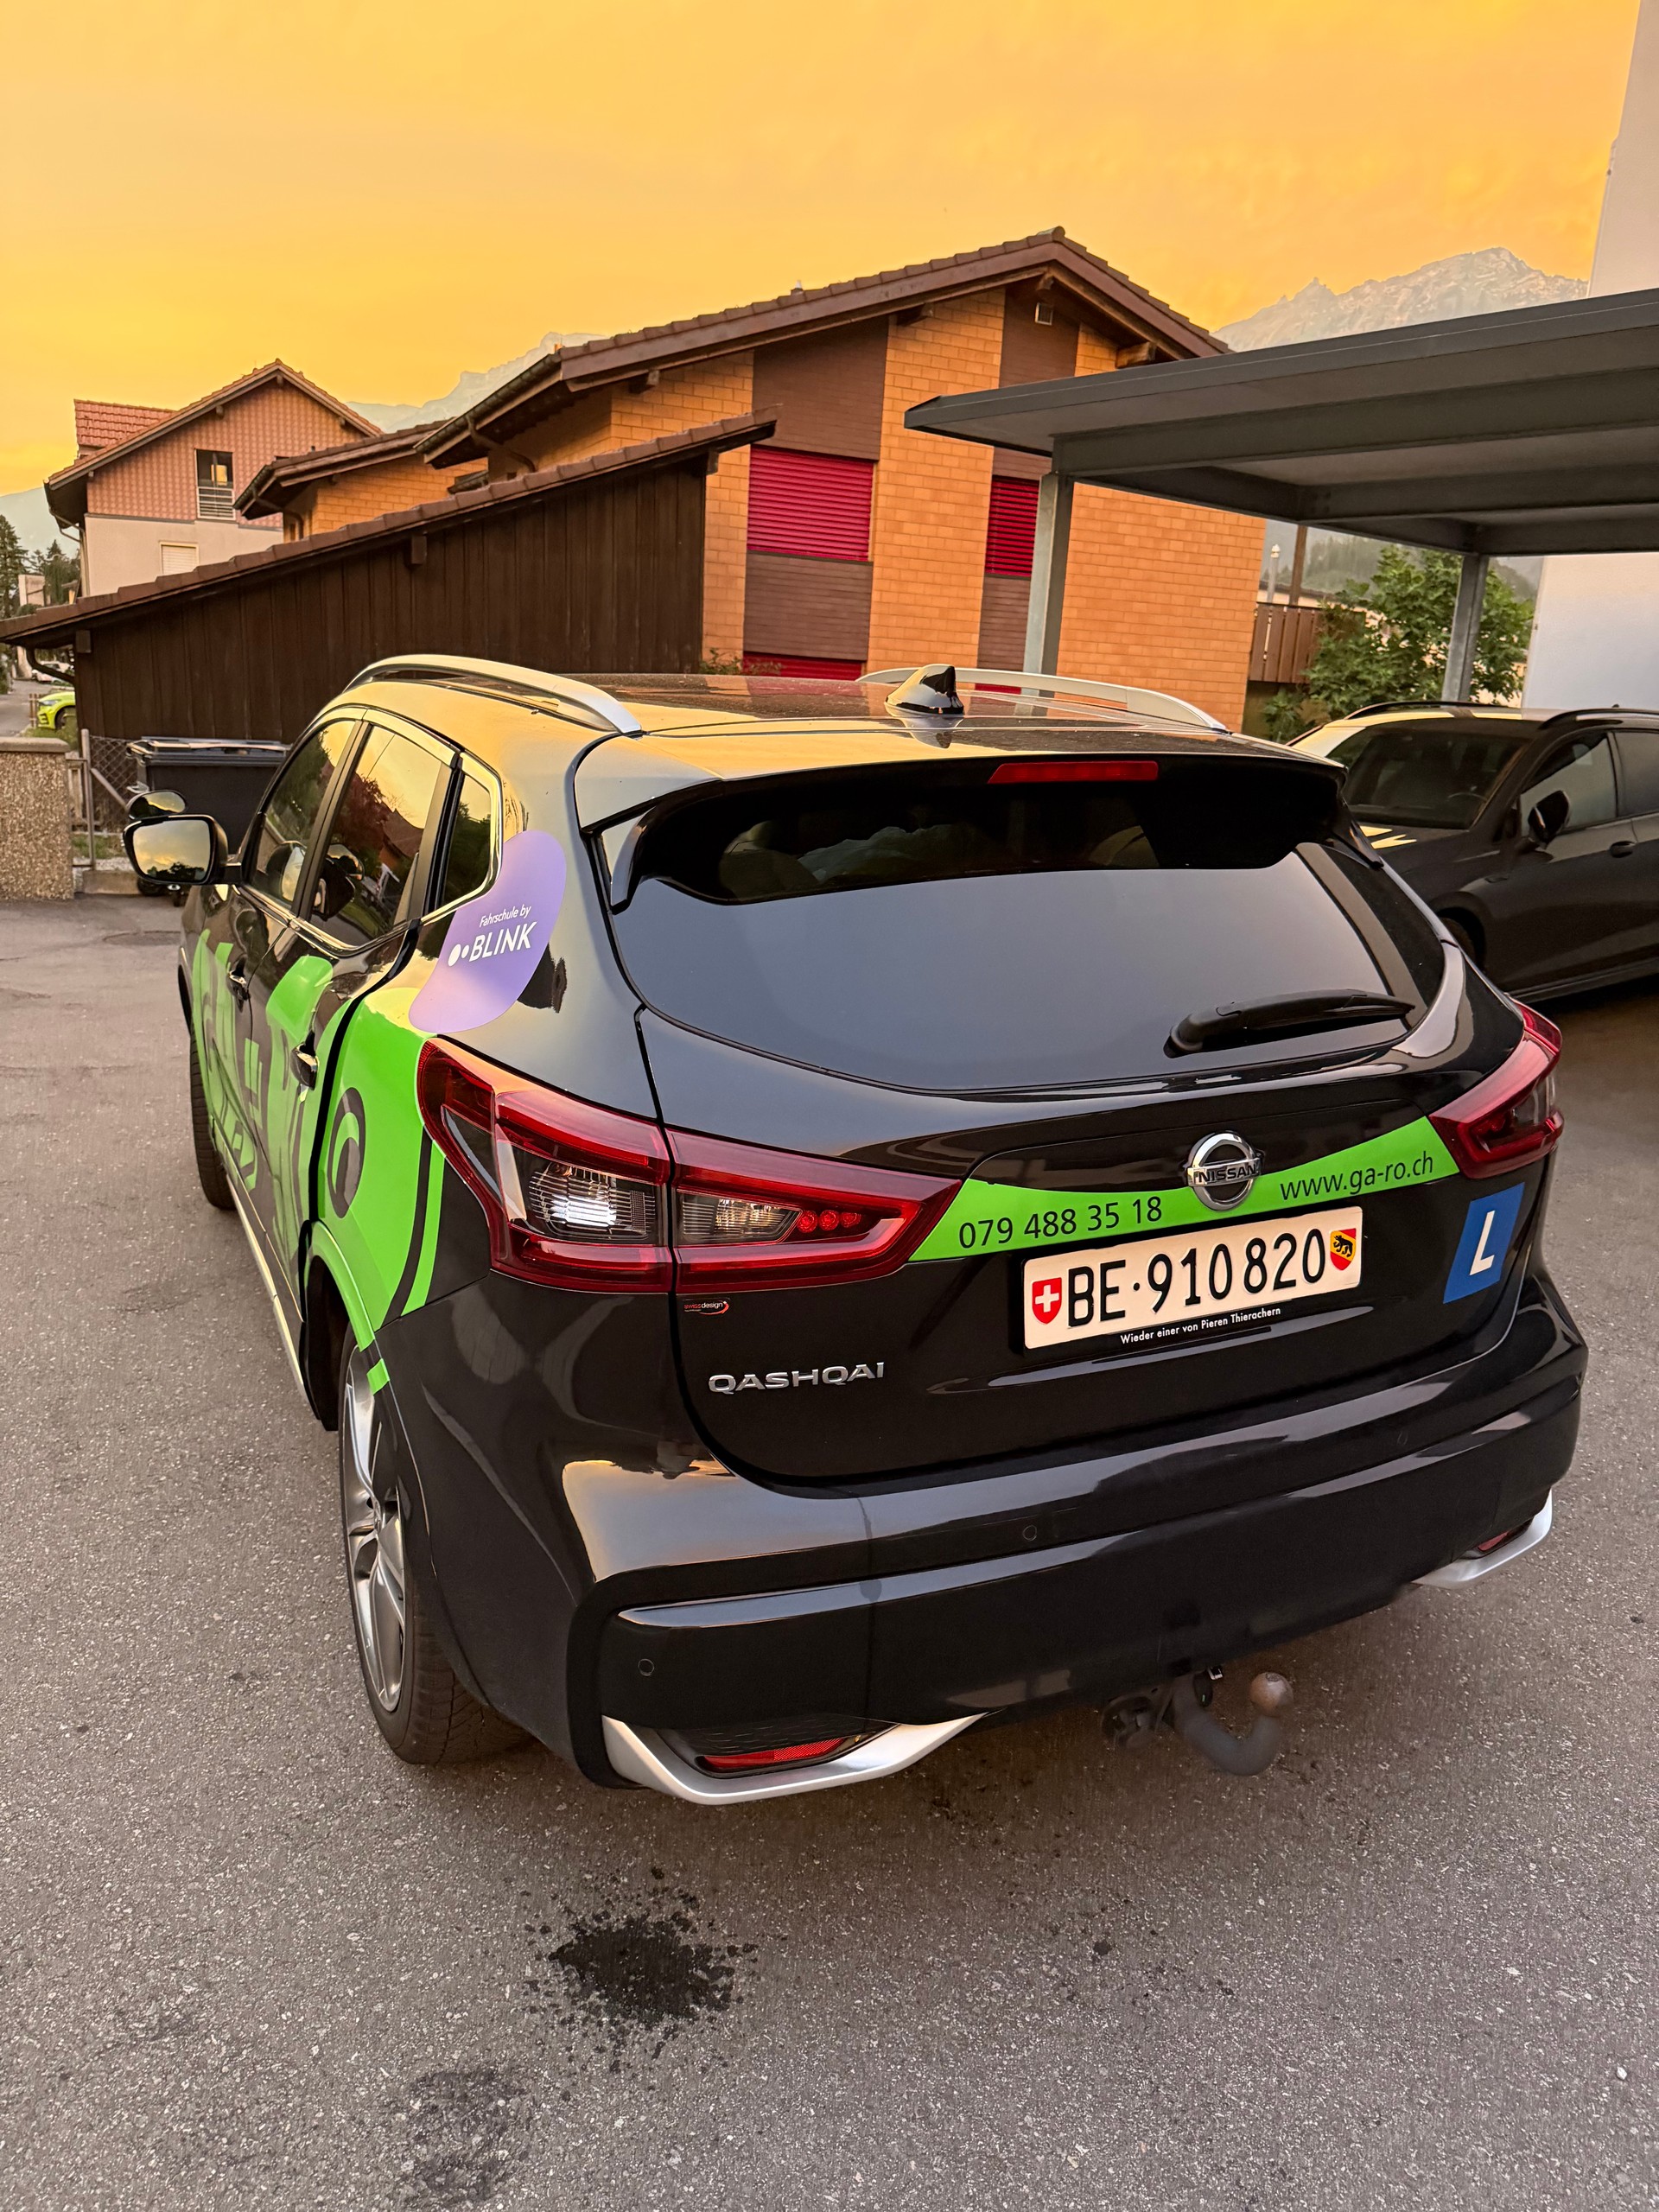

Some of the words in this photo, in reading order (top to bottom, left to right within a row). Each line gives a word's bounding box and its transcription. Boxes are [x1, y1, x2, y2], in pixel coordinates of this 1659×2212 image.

[479, 906, 518, 928] Fahrschule
[519, 904, 532, 919] by
[468, 921, 537, 963] BLINK
[1197, 1164, 1256, 1184] NISSAN
[1280, 1150, 1433, 1201] www.ga-ro.ch
[958, 1217, 1014, 1249] 079
[1024, 1208, 1077, 1239] 488
[1087, 1202, 1120, 1231] 35
[1132, 1196, 1162, 1224] 18
[1469, 1210, 1496, 1277] L
[1120, 1330, 1154, 1344] Wieder
[1157, 1327, 1179, 1338] einer
[1182, 1324, 1198, 1332] von
[1200, 1318, 1229, 1330] Pieren
[1230, 1307, 1281, 1324] Thierachern
[708, 1361, 885, 1395] QASHQAI
